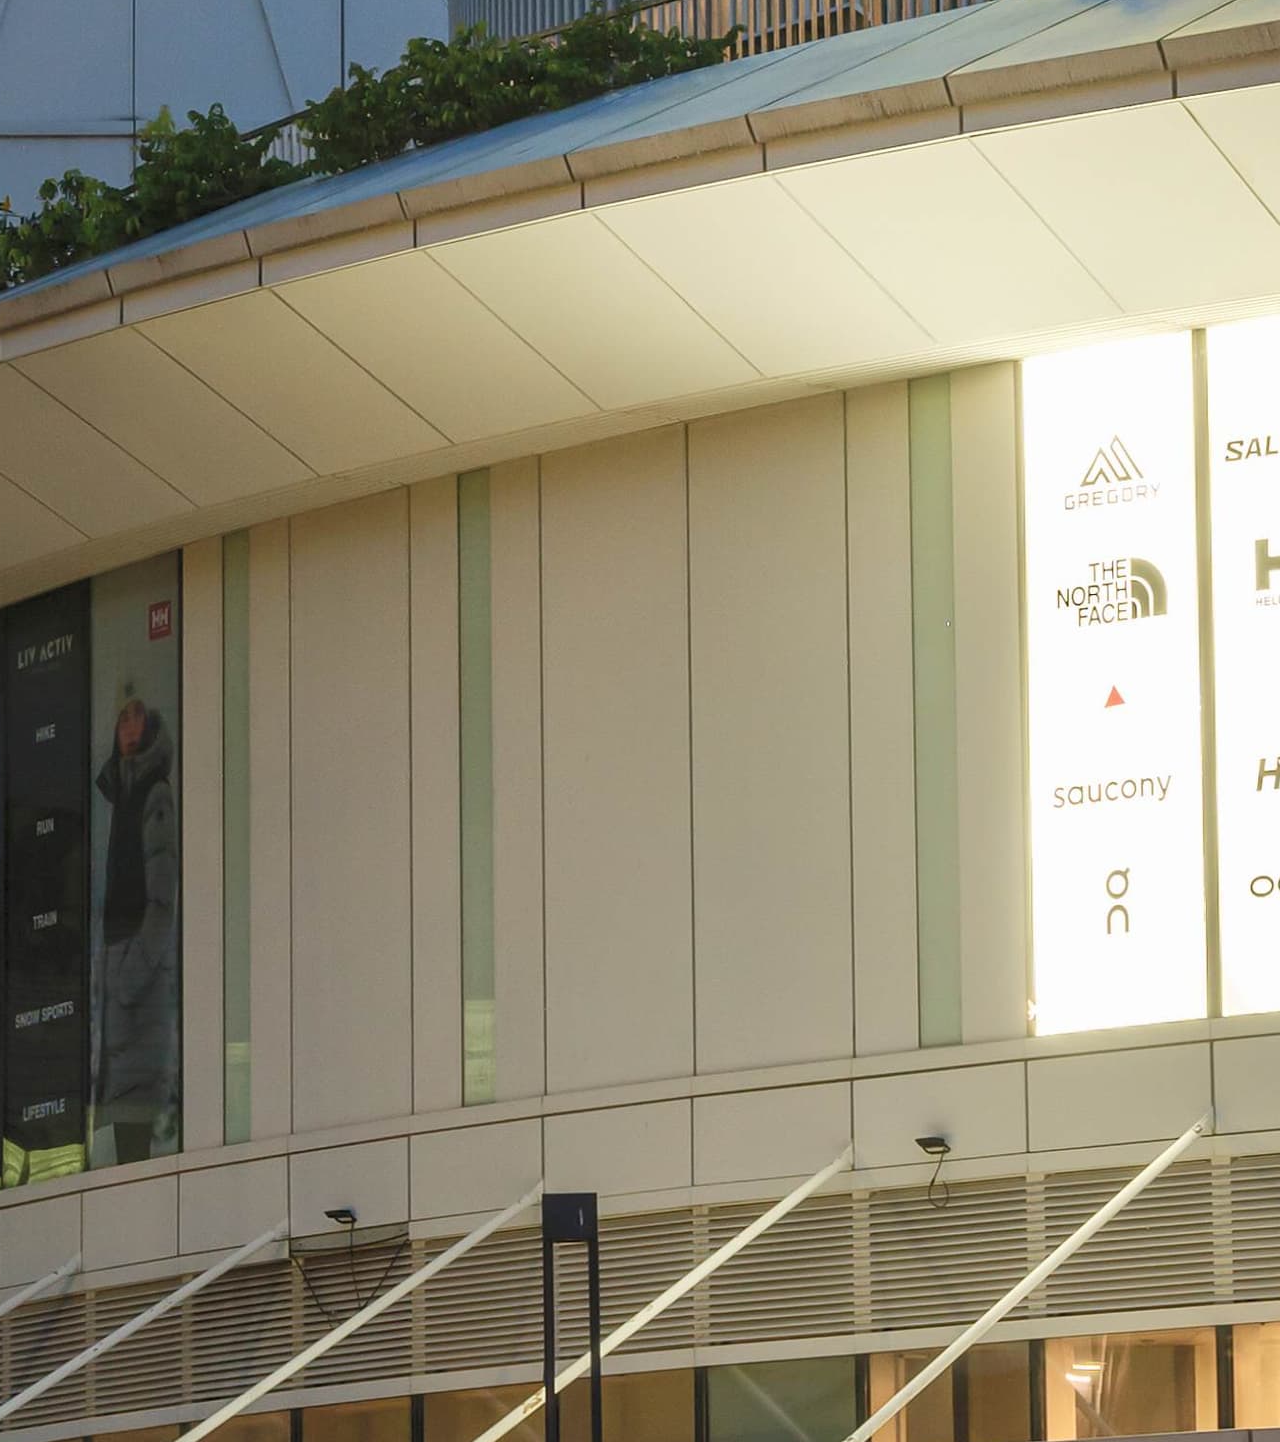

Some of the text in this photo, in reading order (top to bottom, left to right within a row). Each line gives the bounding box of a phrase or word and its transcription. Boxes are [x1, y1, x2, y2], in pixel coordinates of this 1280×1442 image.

[1063, 481, 1161, 511] GREGORY
[1088, 558, 1128, 582] THE
[1056, 580, 1129, 609] NORTH
[1078, 601, 1129, 627] FACE
[35, 723, 56, 743] HIKE
[1053, 773, 1173, 809] saucony
[36, 816, 55, 837] RUN
[32, 909, 58, 931] TRAIN
[15, 1000, 75, 1030] SNOW SPORTS
[22, 1097, 66, 1123] LIFESTYLE
